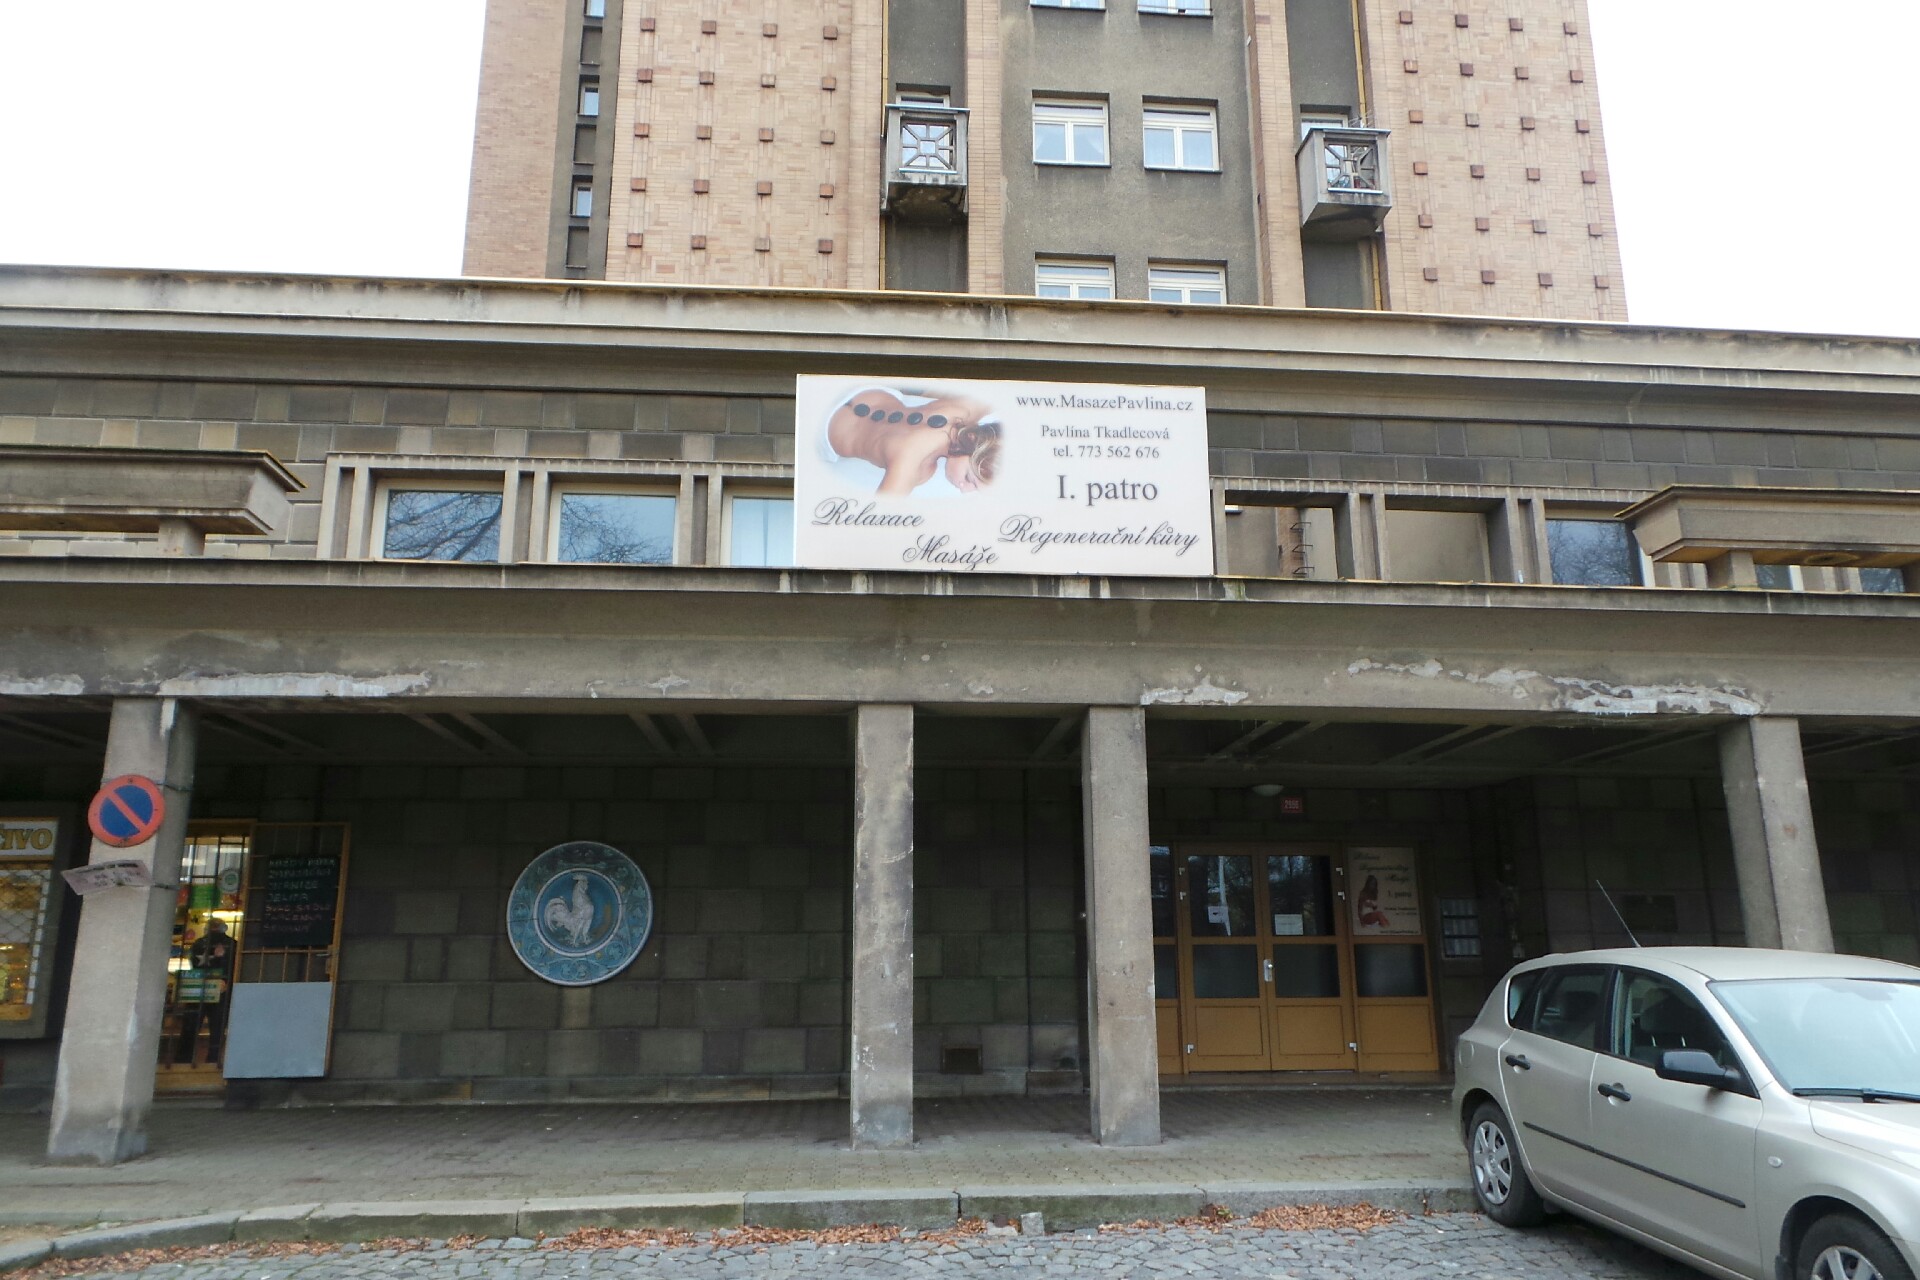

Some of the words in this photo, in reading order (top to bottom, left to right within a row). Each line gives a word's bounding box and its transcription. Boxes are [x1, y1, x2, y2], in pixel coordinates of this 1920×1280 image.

[1016, 395, 1193, 411] www.MasazePavlina.cz
[1041, 425, 1090, 438] Pavlína
[1094, 426, 1170, 440] Tkadlecová
[1053, 445, 1073, 458] tel.
[1078, 446, 1101, 458] 773
[1107, 446, 1131, 459] 562
[1135, 447, 1160, 459] 676
[1086, 478, 1158, 506] patro
[811, 497, 925, 527] Relaxace
[997, 514, 1146, 554] Regenerační
[1145, 521, 1199, 556] kůry
[902, 534, 999, 570] Masáže
